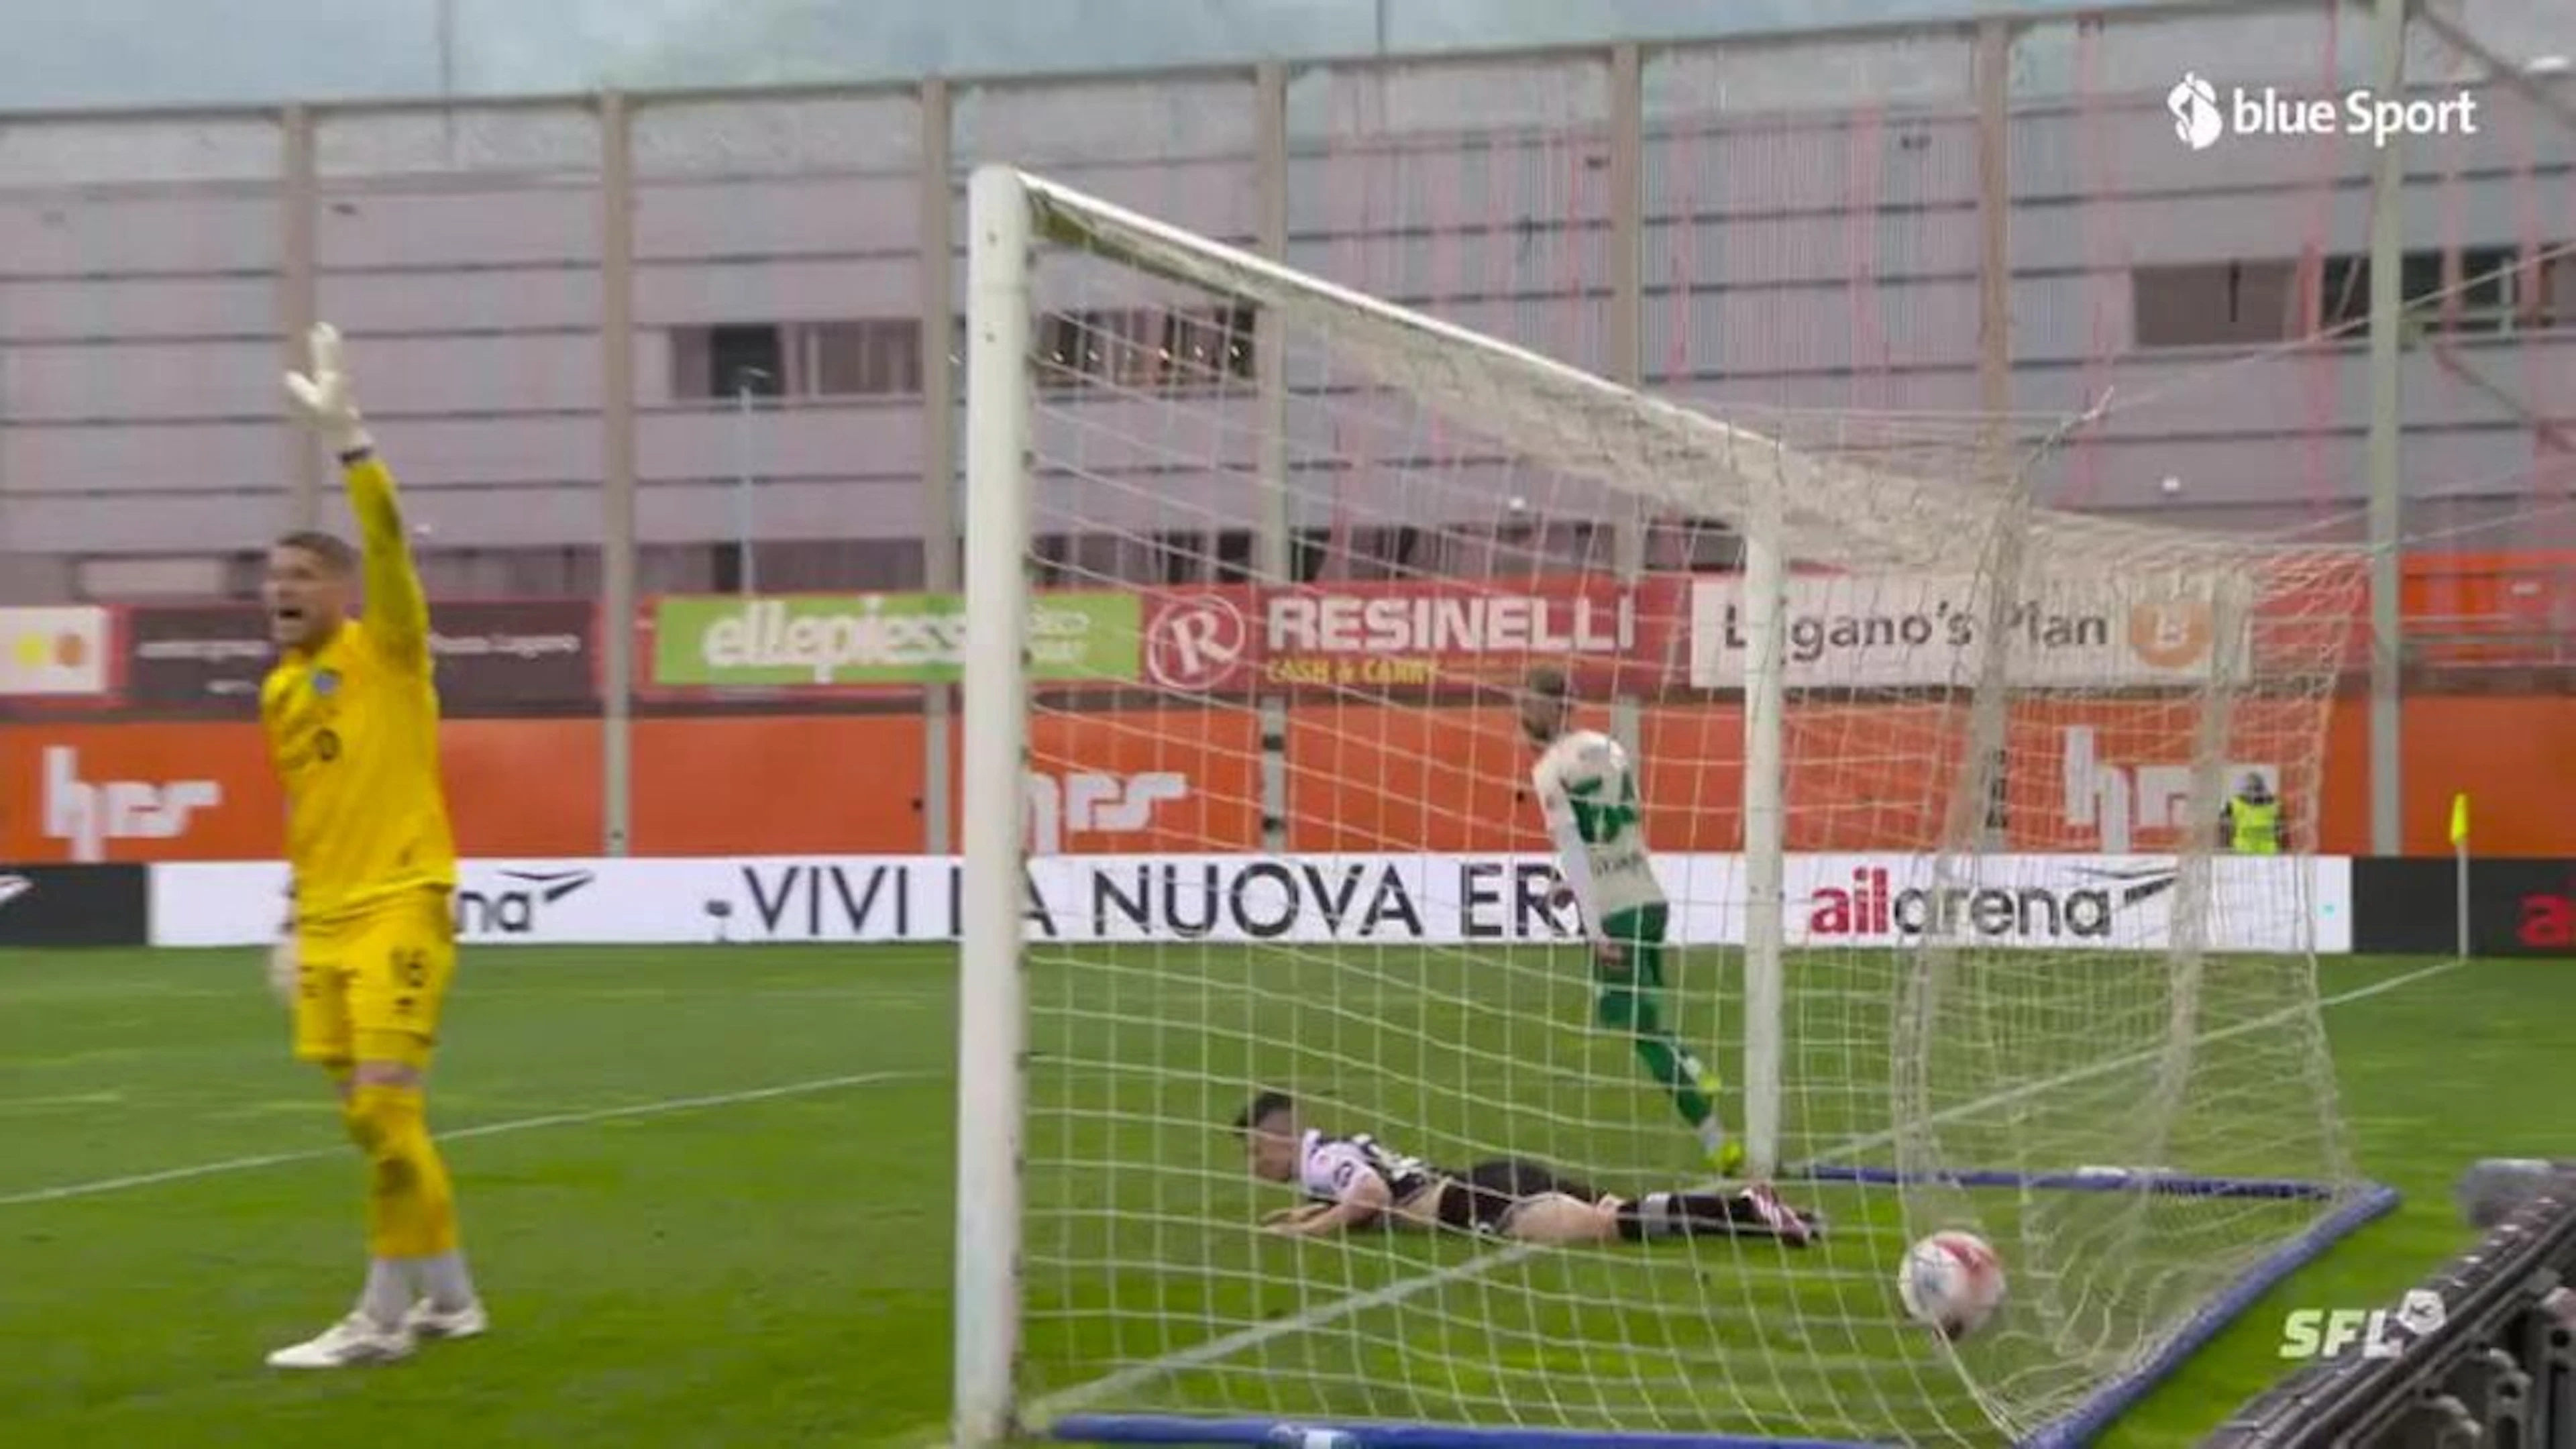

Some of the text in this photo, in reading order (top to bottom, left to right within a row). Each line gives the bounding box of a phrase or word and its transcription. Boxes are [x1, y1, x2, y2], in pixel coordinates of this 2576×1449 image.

[1267, 596, 1635, 651] RESINELLI
[1725, 598, 1974, 663] Lgano's
[742, 865, 907, 936] VIVI
[1093, 863, 1423, 938] NUOVA
[1460, 863, 1587, 937] ER
